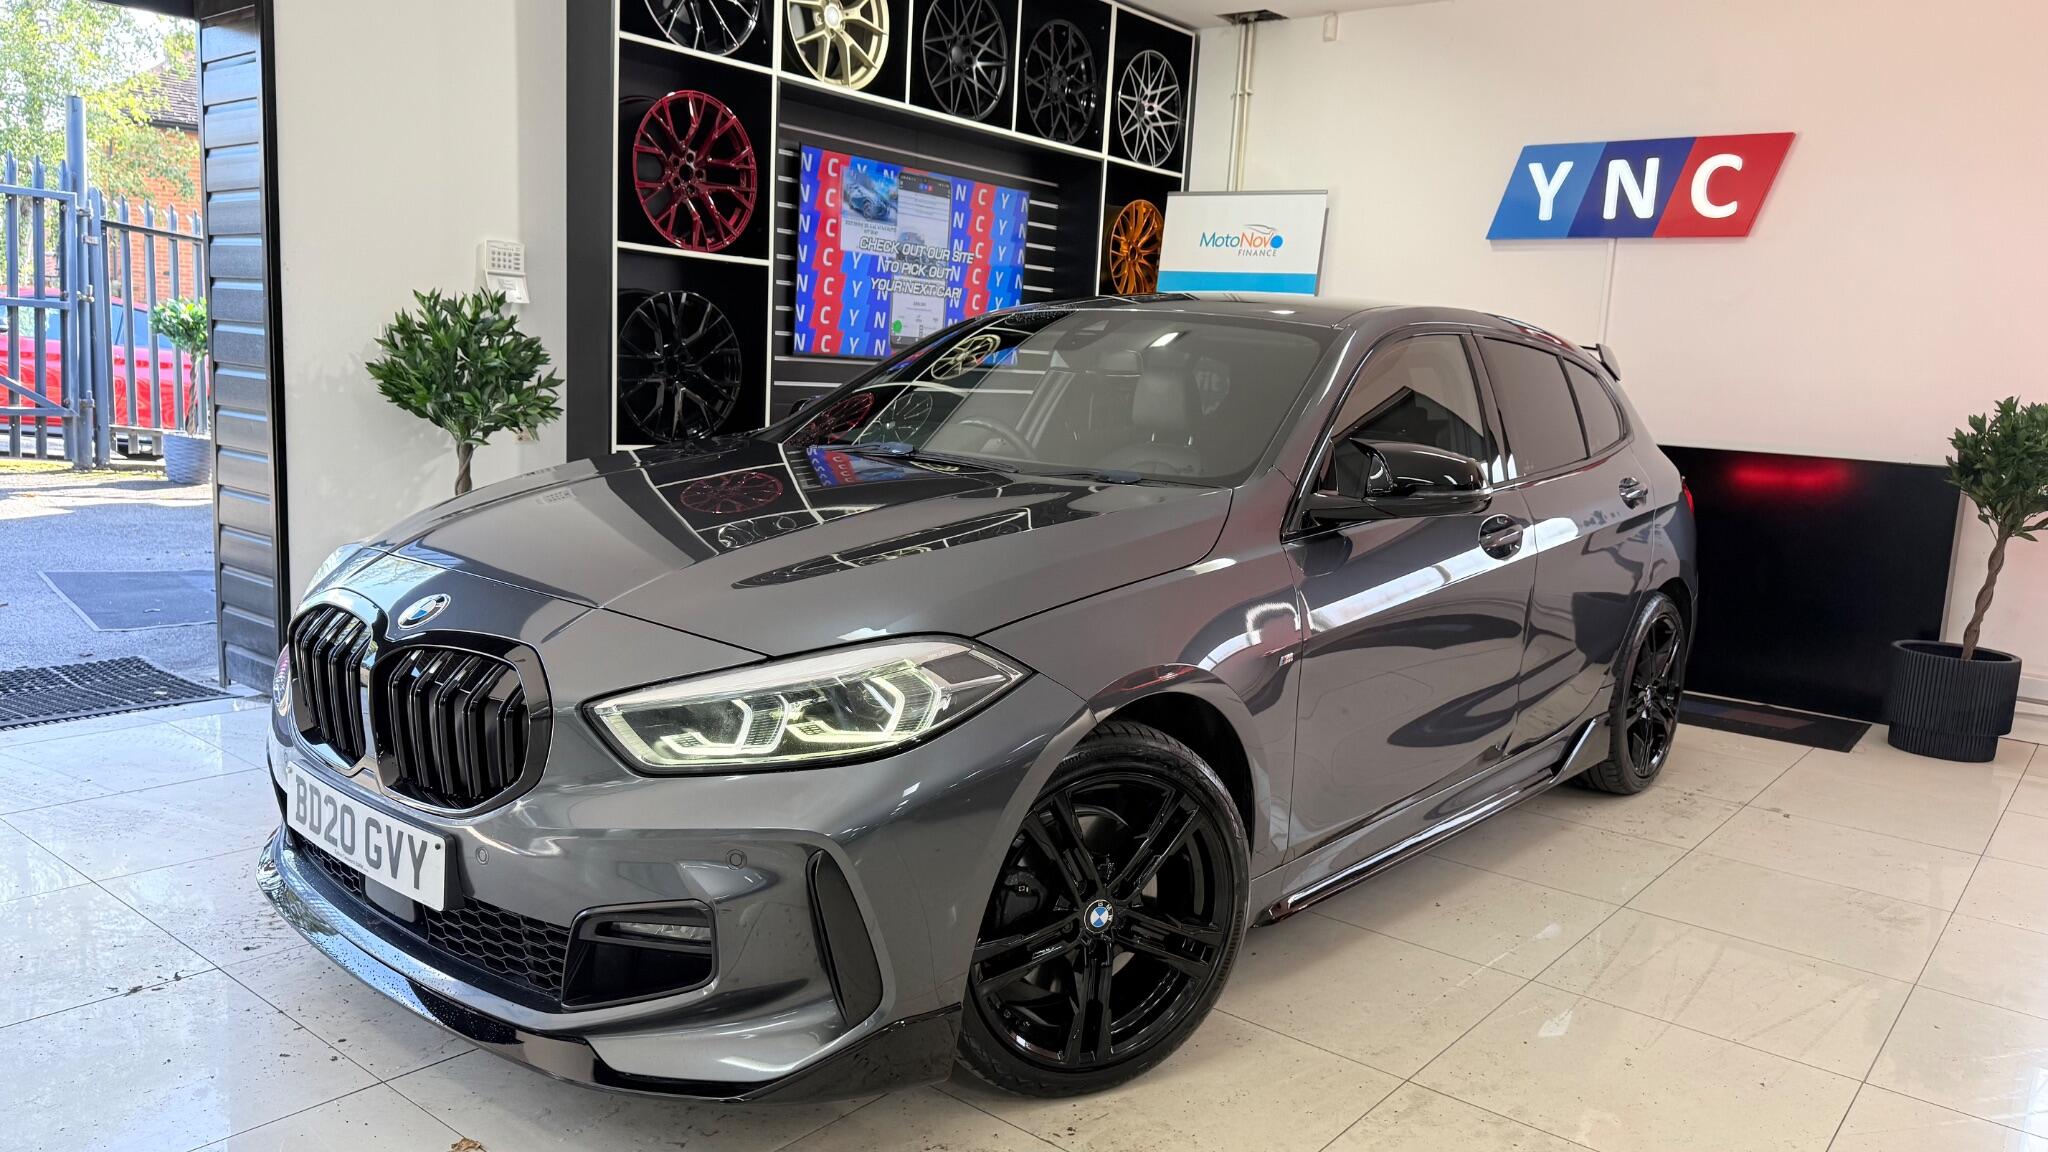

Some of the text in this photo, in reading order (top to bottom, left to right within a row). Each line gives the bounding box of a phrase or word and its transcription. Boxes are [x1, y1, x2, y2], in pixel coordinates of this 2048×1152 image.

[1528, 153, 1743, 221] YNC
[860, 236, 975, 264] CHECK OUT OUR SITE
[1237, 248, 1278, 257] FINANCE
[885, 260, 953, 280] TO PICK OUT
[871, 277, 902, 292] YOUR
[903, 281, 935, 297] NEXT
[296, 775, 428, 891] BD20 GVY
